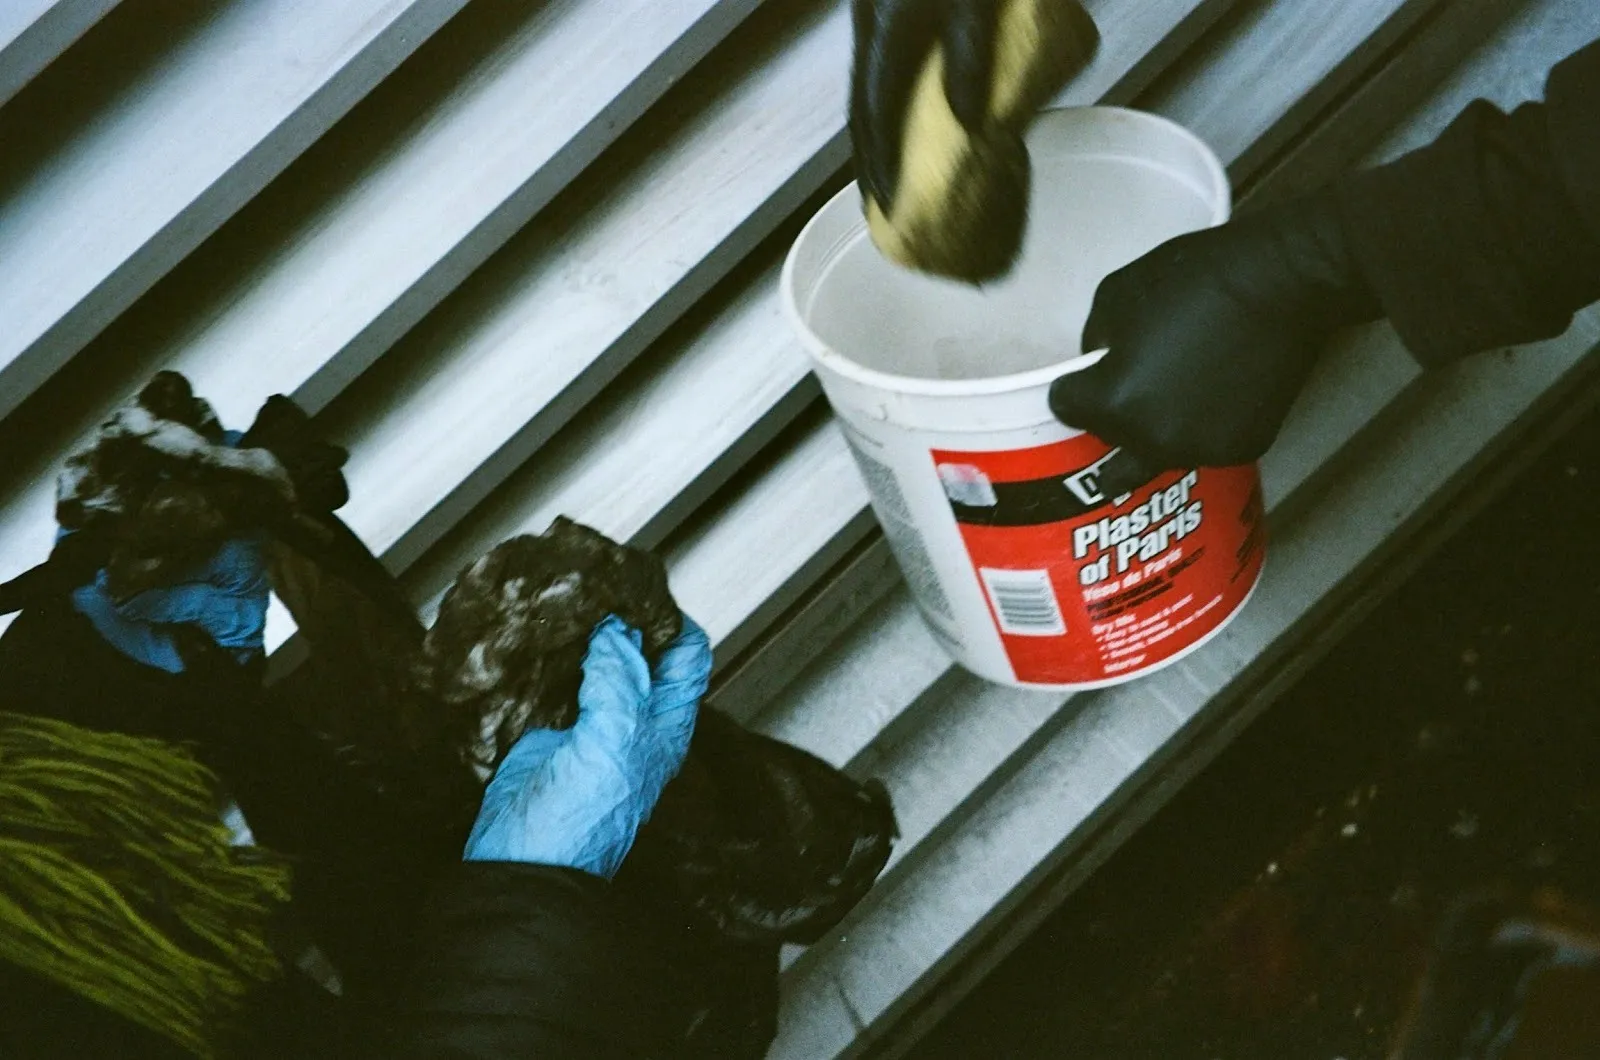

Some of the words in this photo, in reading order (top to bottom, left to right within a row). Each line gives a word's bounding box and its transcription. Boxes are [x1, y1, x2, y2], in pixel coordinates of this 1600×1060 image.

[1073, 469, 1198, 559] Plaster
[1079, 554, 1110, 586] of
[1116, 500, 1203, 574] Paris
